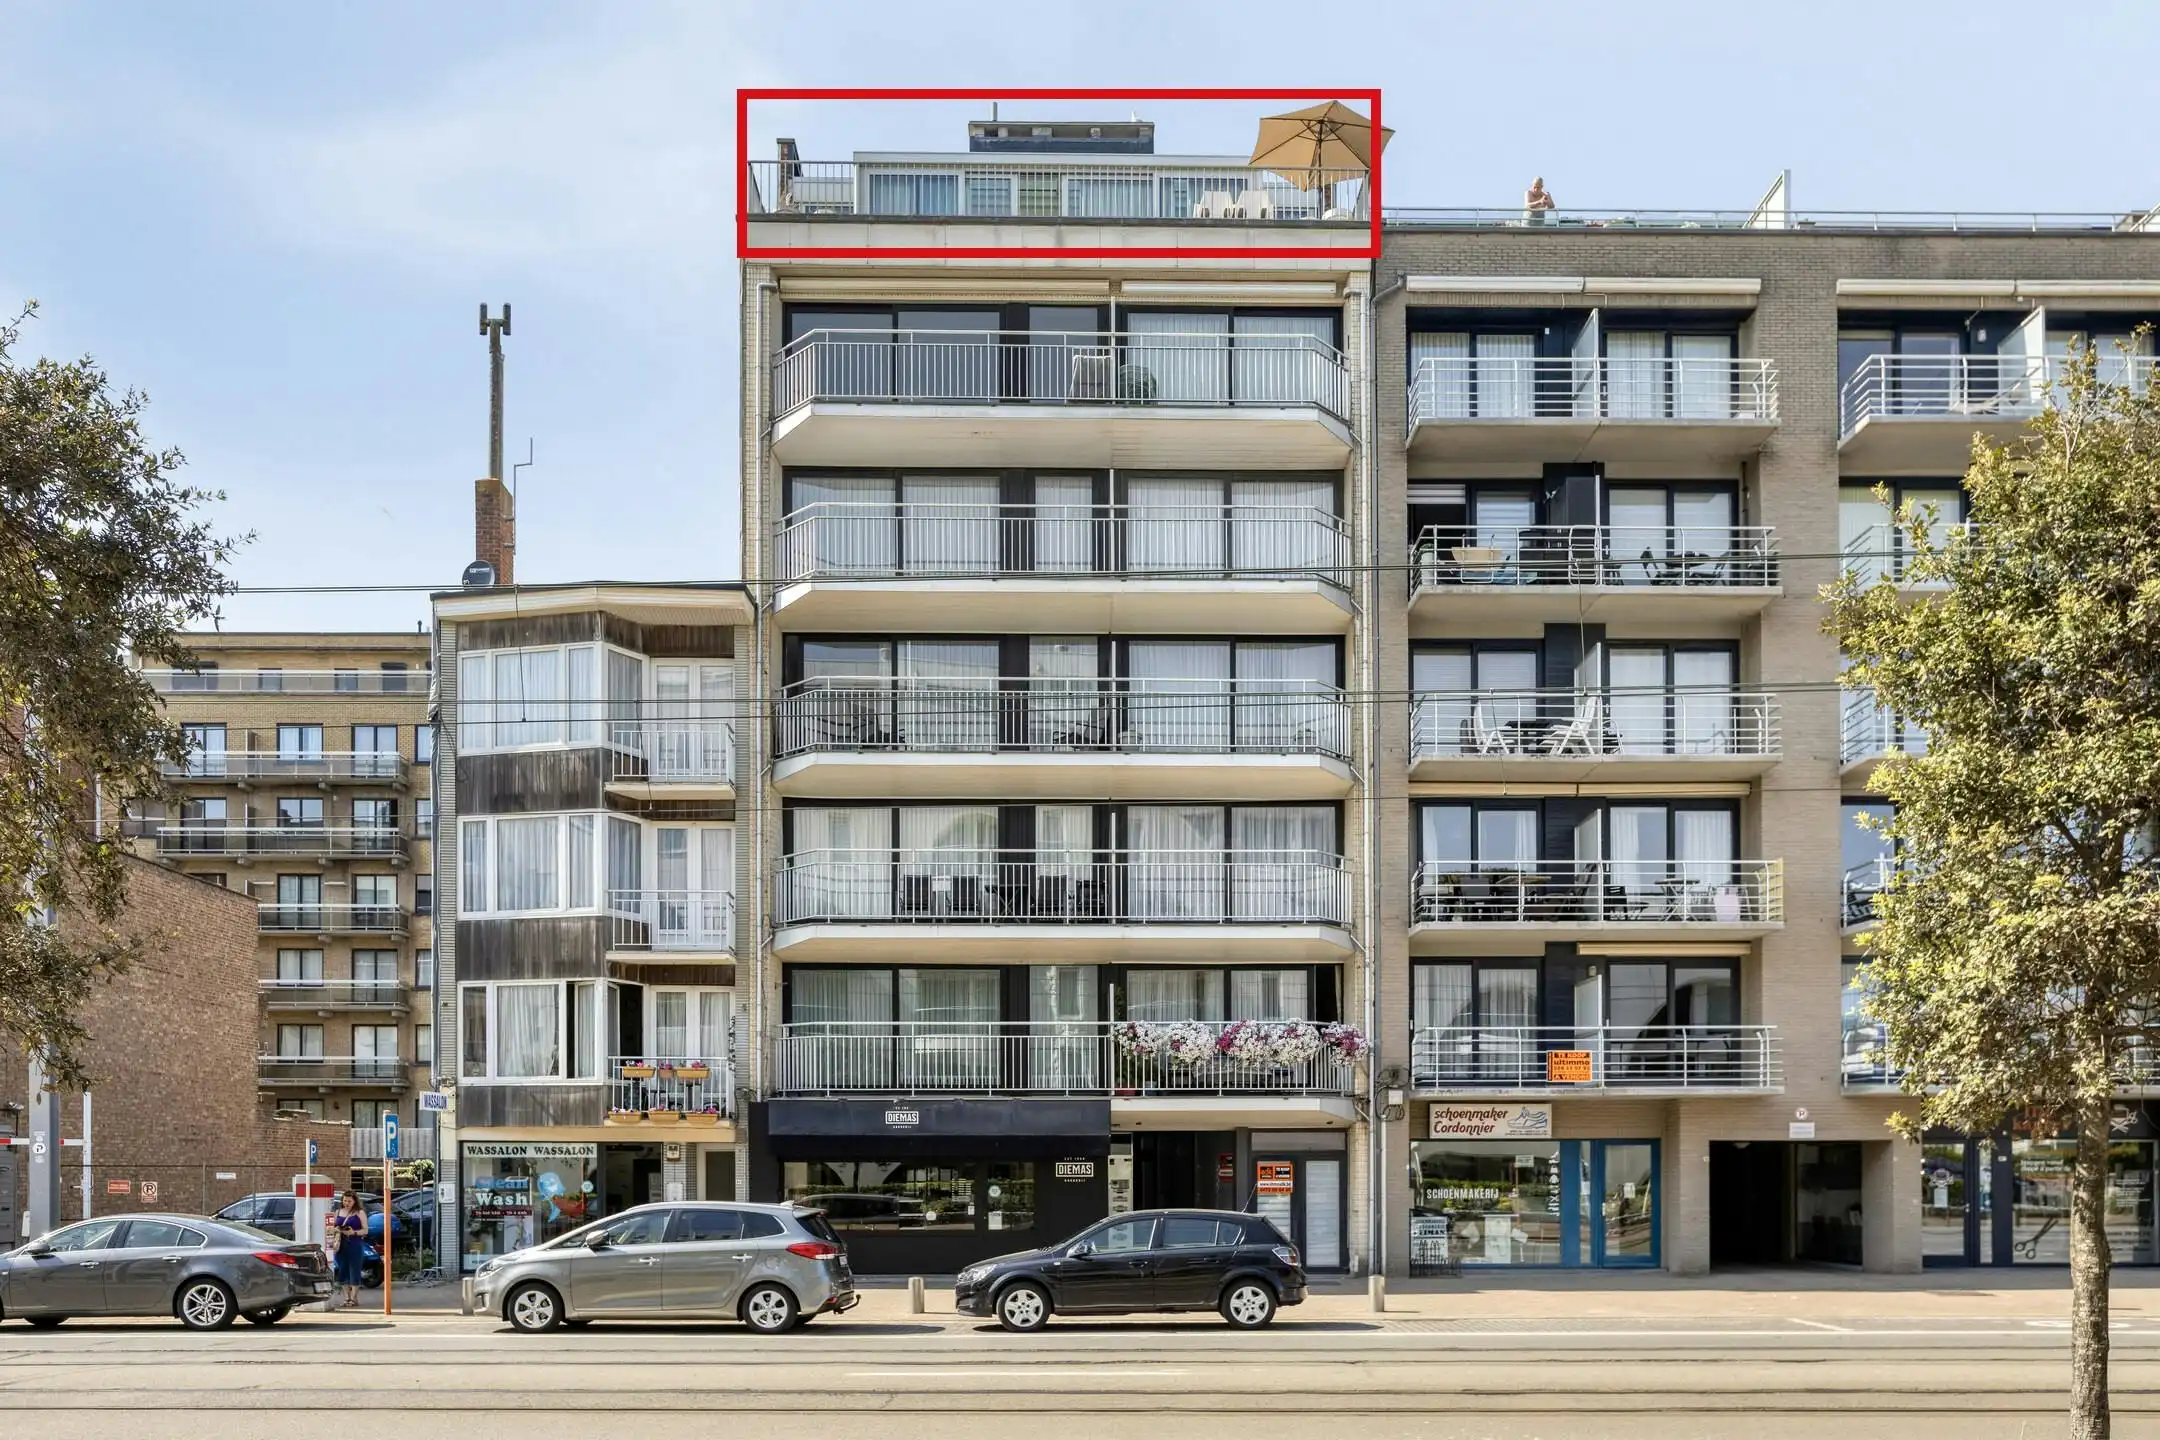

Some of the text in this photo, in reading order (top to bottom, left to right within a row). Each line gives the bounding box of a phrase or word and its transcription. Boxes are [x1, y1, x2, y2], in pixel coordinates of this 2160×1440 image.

[888, 1113, 917, 1122] DIEMAS
[1434, 1107, 1508, 1121] schoenmaker
[1434, 1120, 1496, 1135] Cordonnier
[386, 1121, 397, 1153] P
[310, 1144, 317, 1159] P
[467, 1146, 594, 1155] WASSALON WASSALON
[1058, 1164, 1091, 1175] DIEMAS
[475, 1192, 529, 1206] Wash
[1426, 1188, 1499, 1199] SCHOENMAKERIJ
